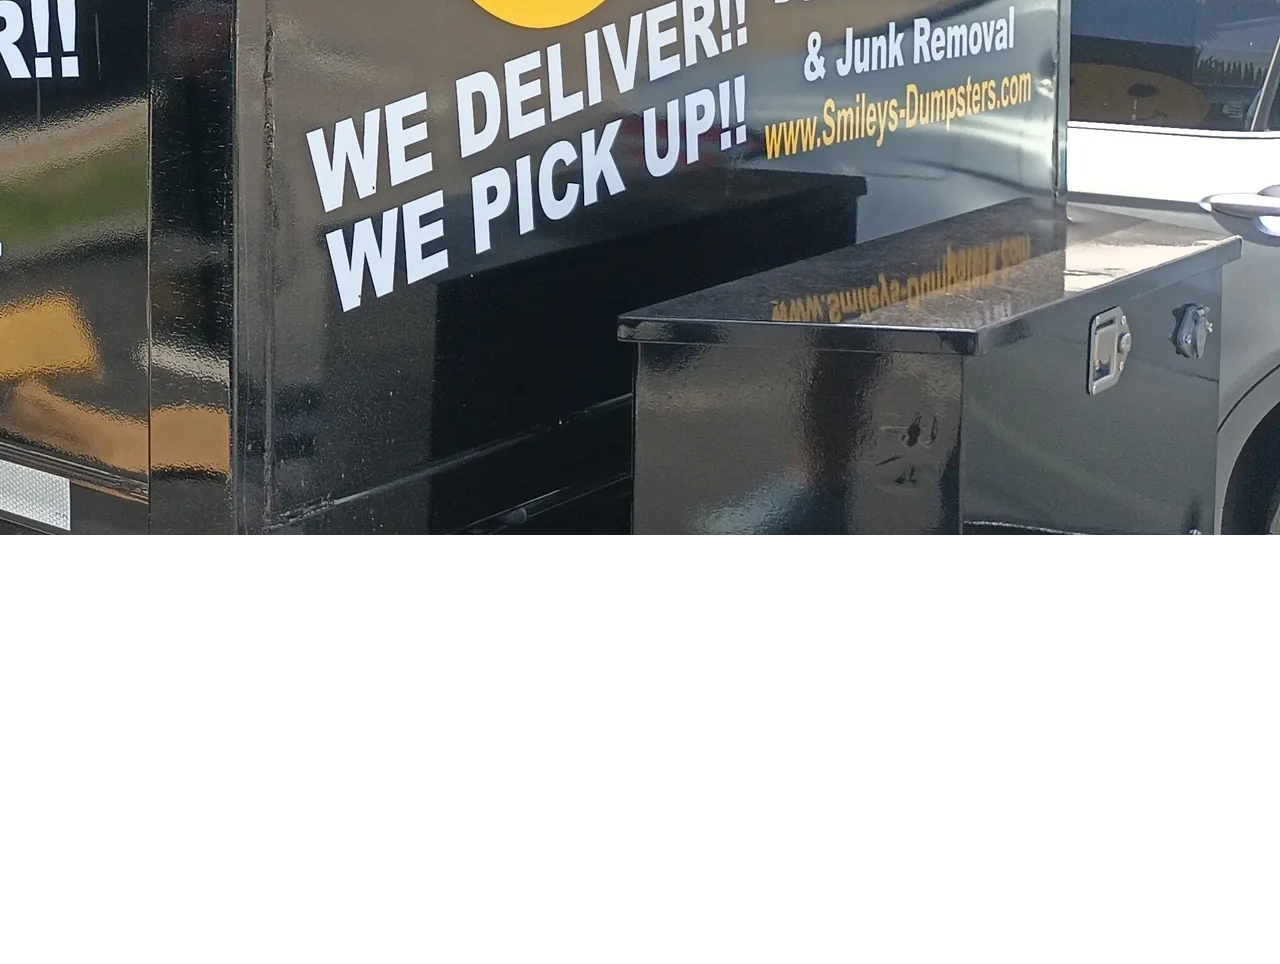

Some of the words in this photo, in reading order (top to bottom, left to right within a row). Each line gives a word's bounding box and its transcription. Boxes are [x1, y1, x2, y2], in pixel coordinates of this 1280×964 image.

[803, 31, 826, 82] &
[835, 21, 905, 77] Junk
[913, 5, 1015, 65] Removal
[306, 91, 434, 213] WE
[764, 72, 1033, 160] www.Smileys-Dumpsters.com
[325, 189, 449, 313] WE
[470, 118, 628, 256] PICK
[642, 74, 748, 178] UP!!
